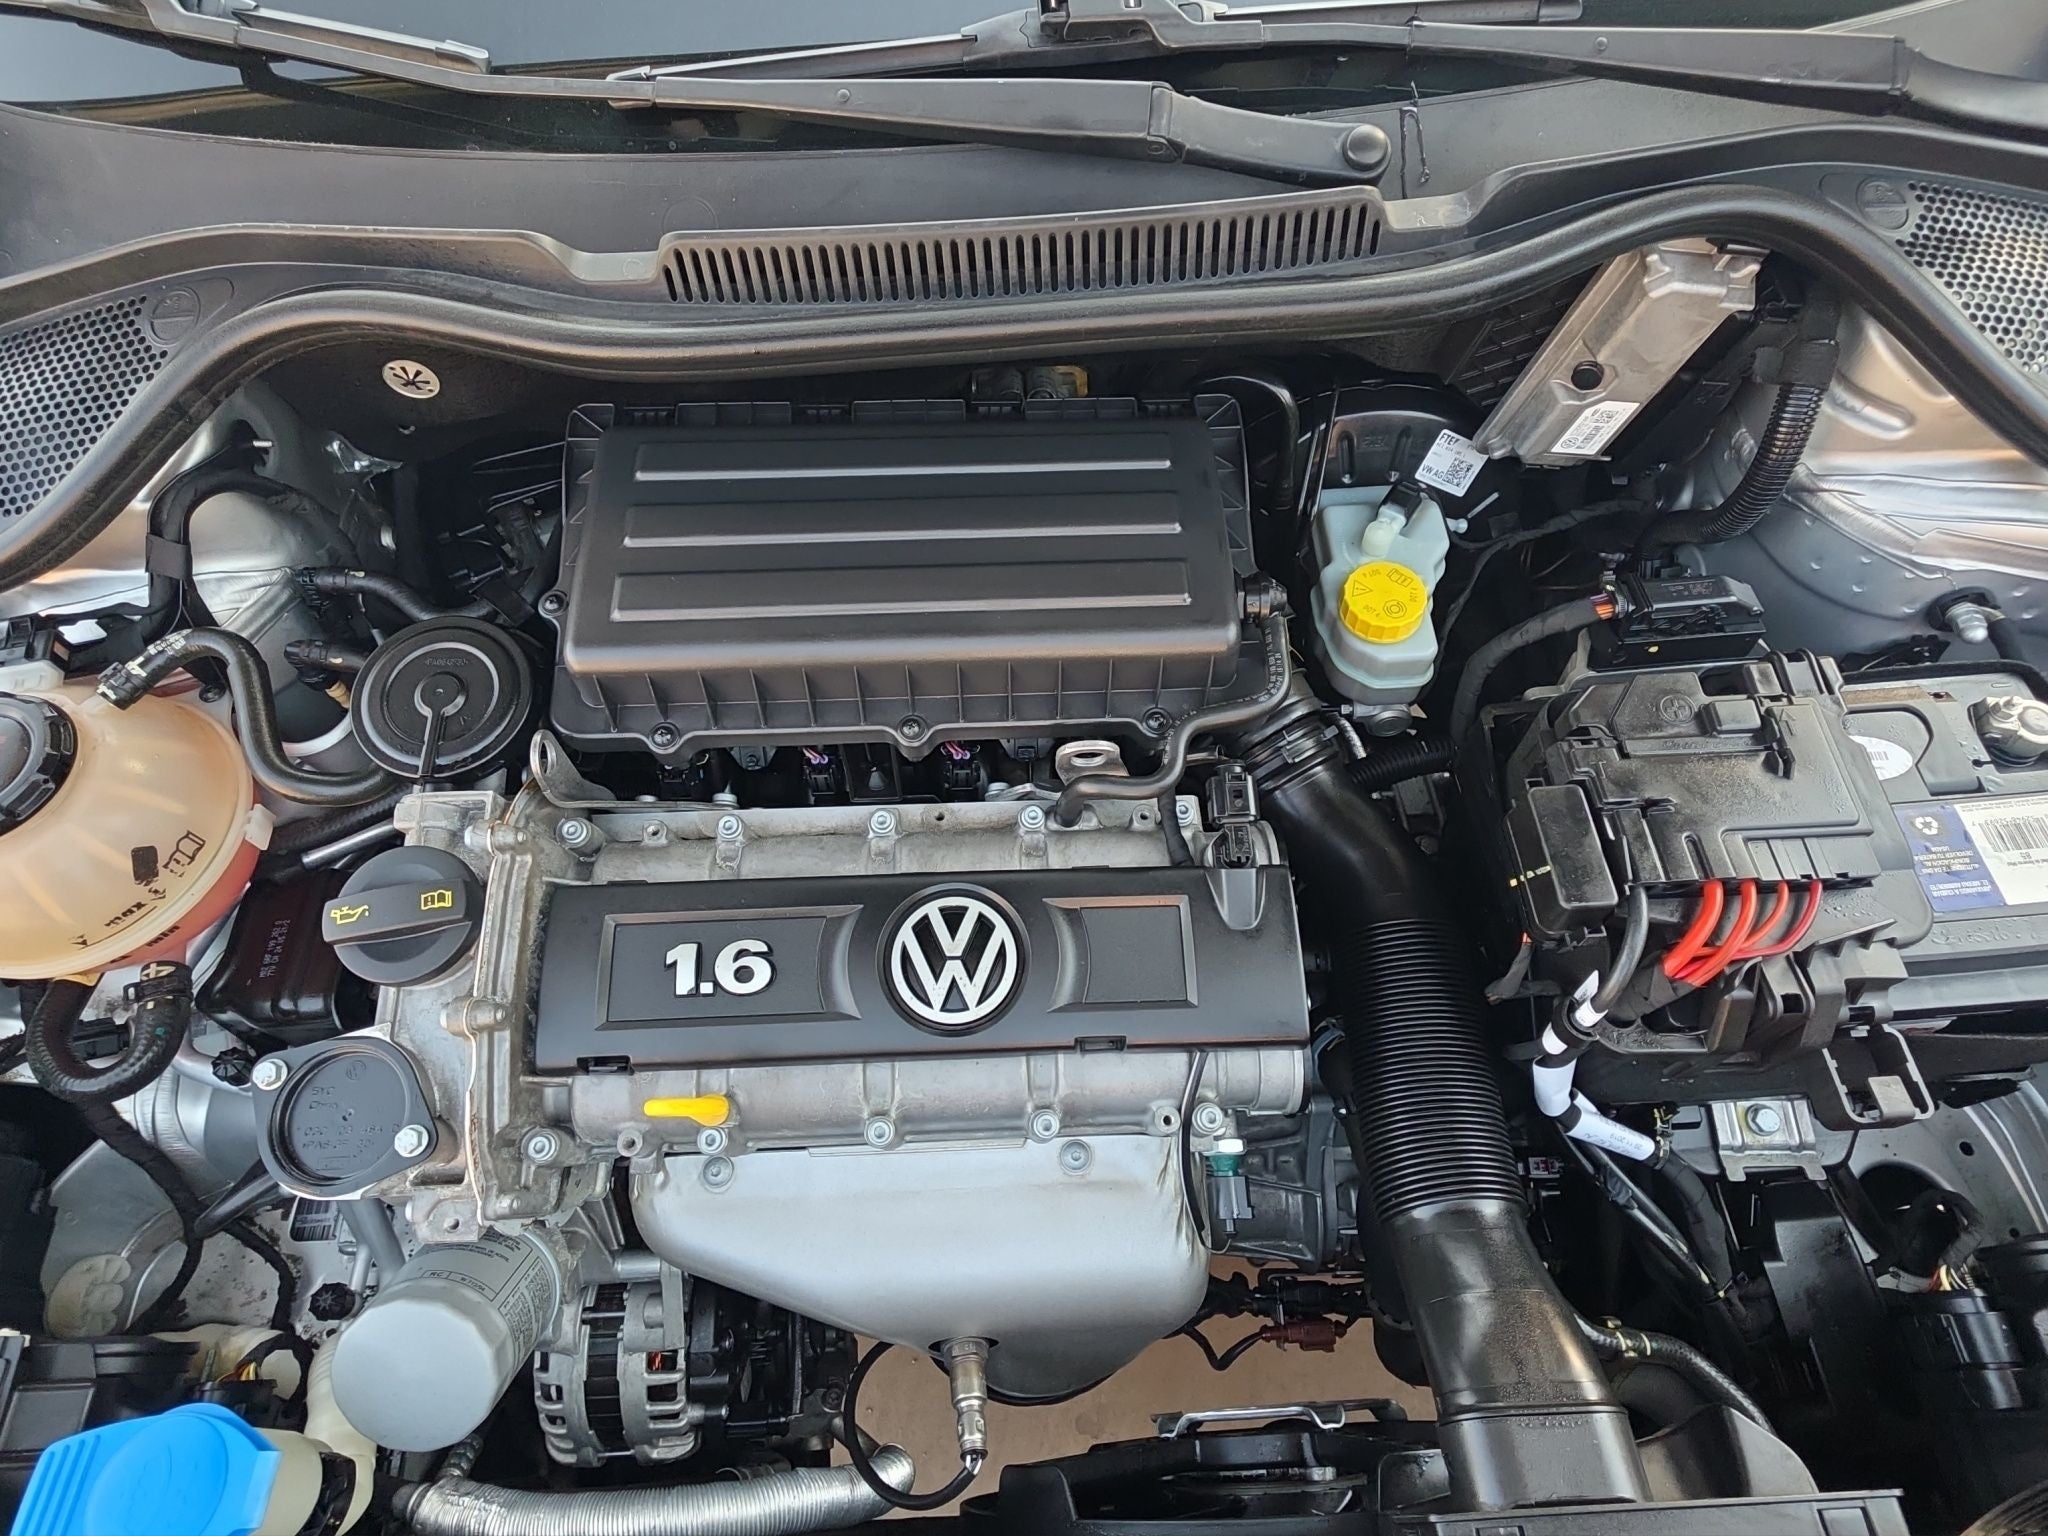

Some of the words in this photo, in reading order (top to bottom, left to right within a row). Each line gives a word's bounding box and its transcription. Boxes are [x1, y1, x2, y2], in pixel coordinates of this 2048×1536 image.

[1421, 464, 1433, 475] VW
[1432, 469, 1444, 480] AG
[664, 938, 775, 999] 1.6
[890, 895, 1018, 1025] VW
